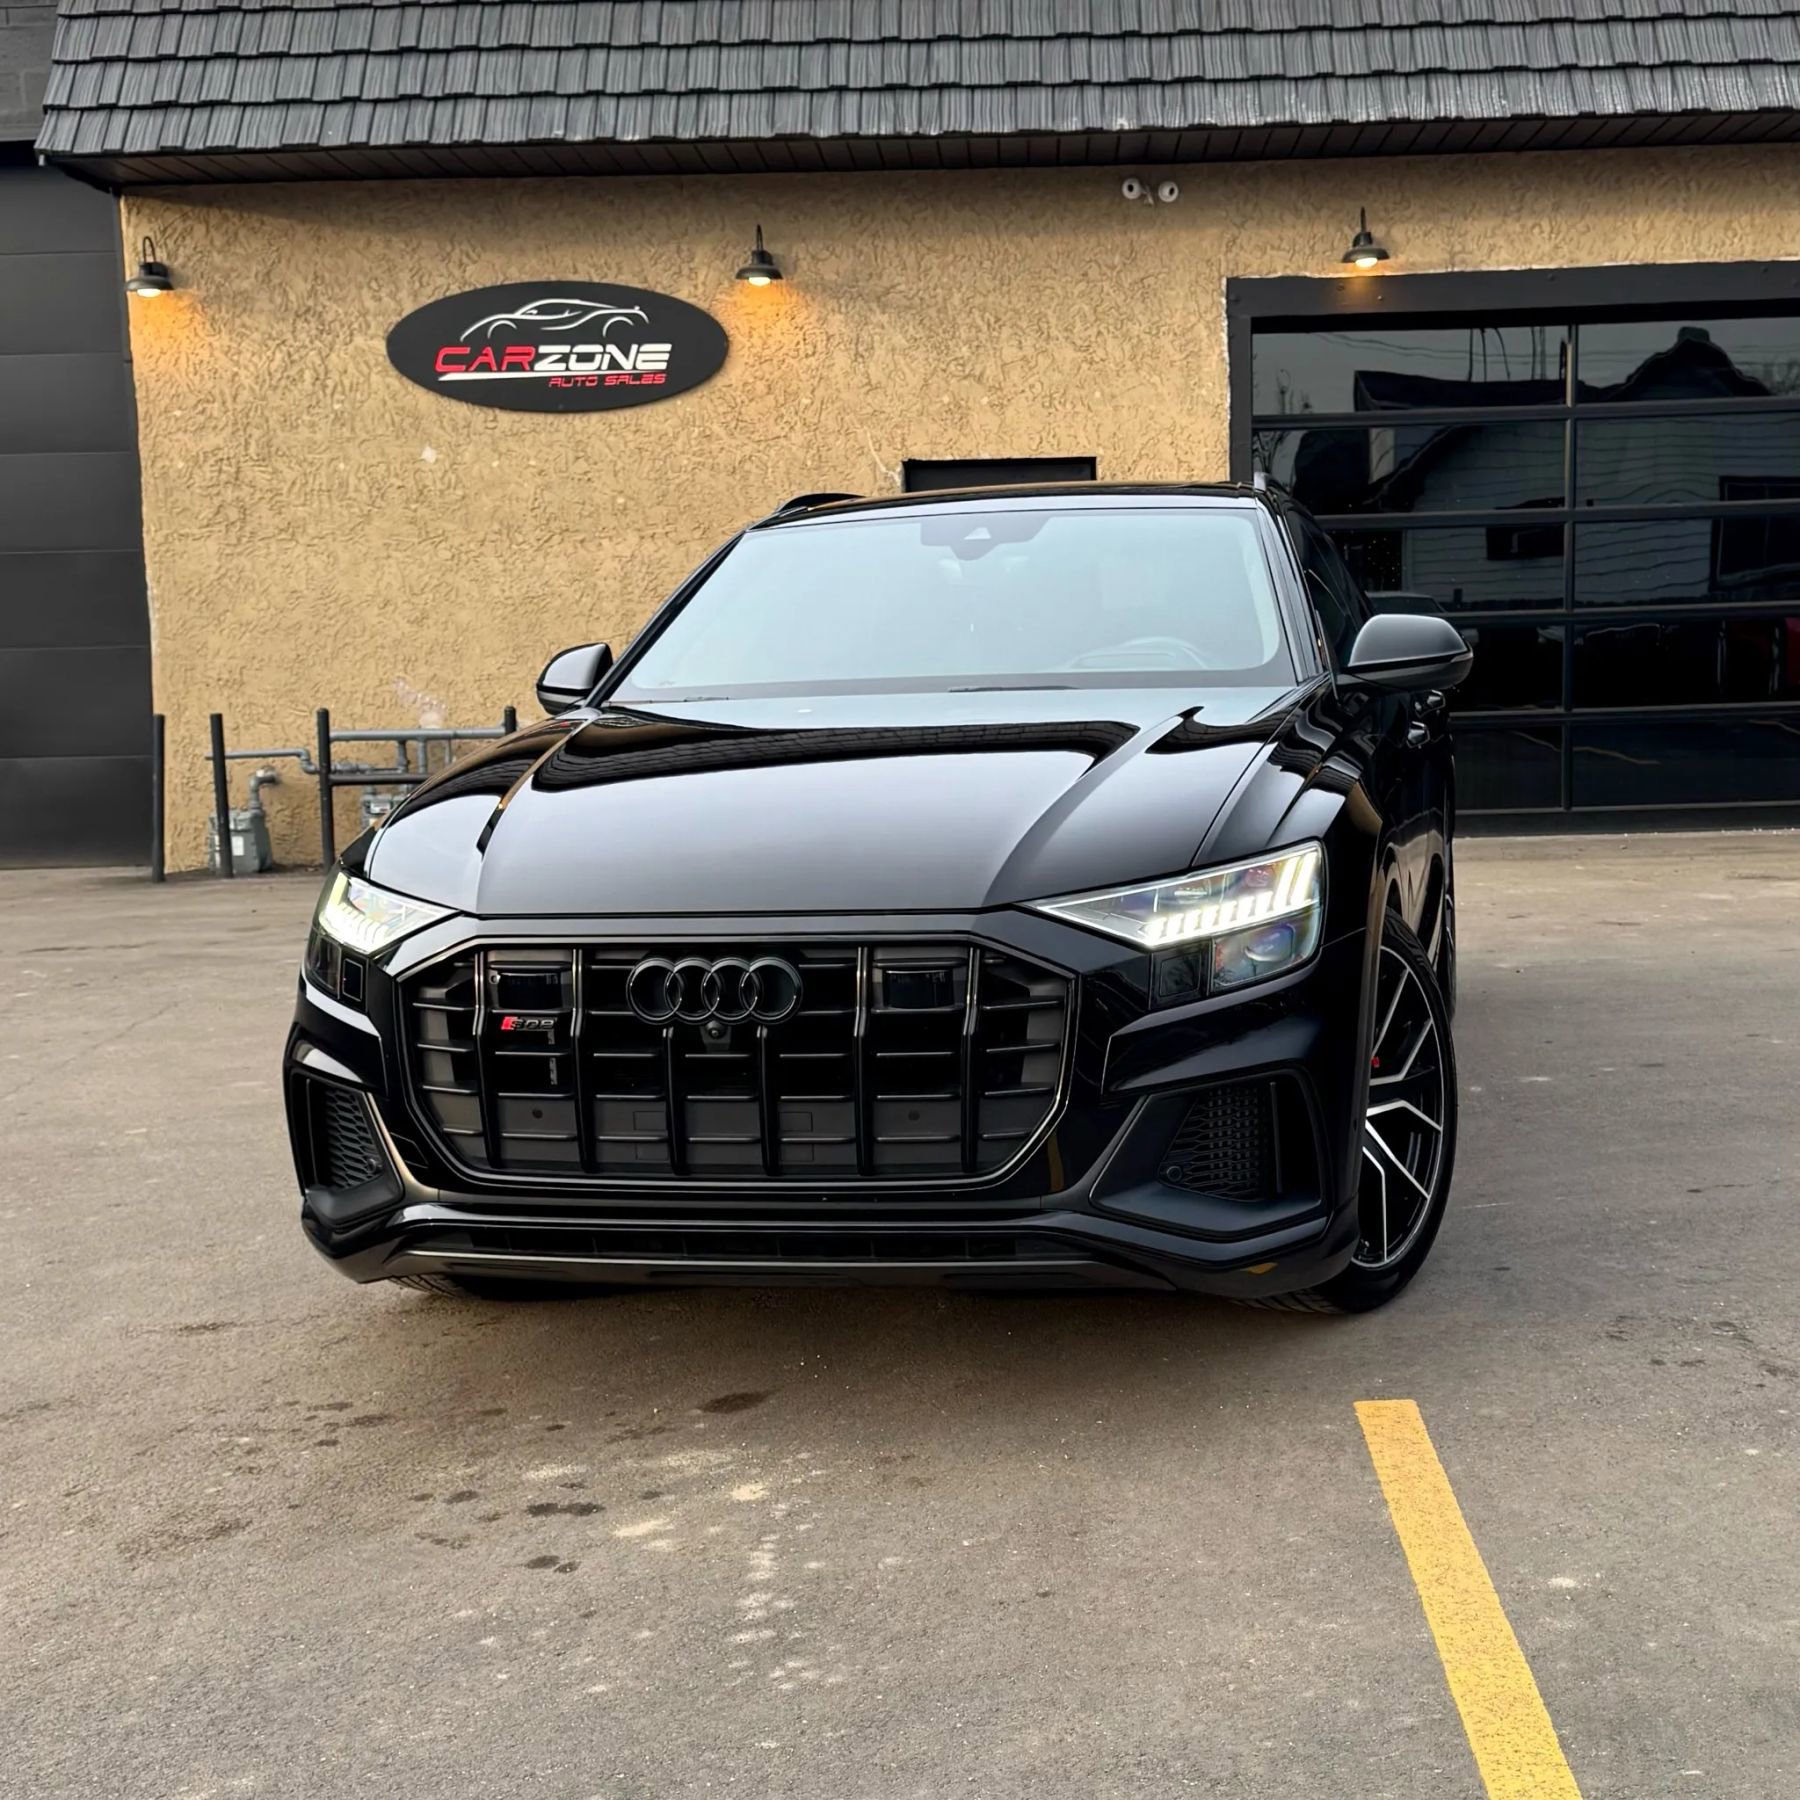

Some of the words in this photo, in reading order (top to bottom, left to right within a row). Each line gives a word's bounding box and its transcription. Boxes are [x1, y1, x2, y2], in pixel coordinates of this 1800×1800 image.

[435, 343, 673, 372] CARZONE
[549, 376, 599, 388] AUTO
[604, 373, 667, 387] SALES
